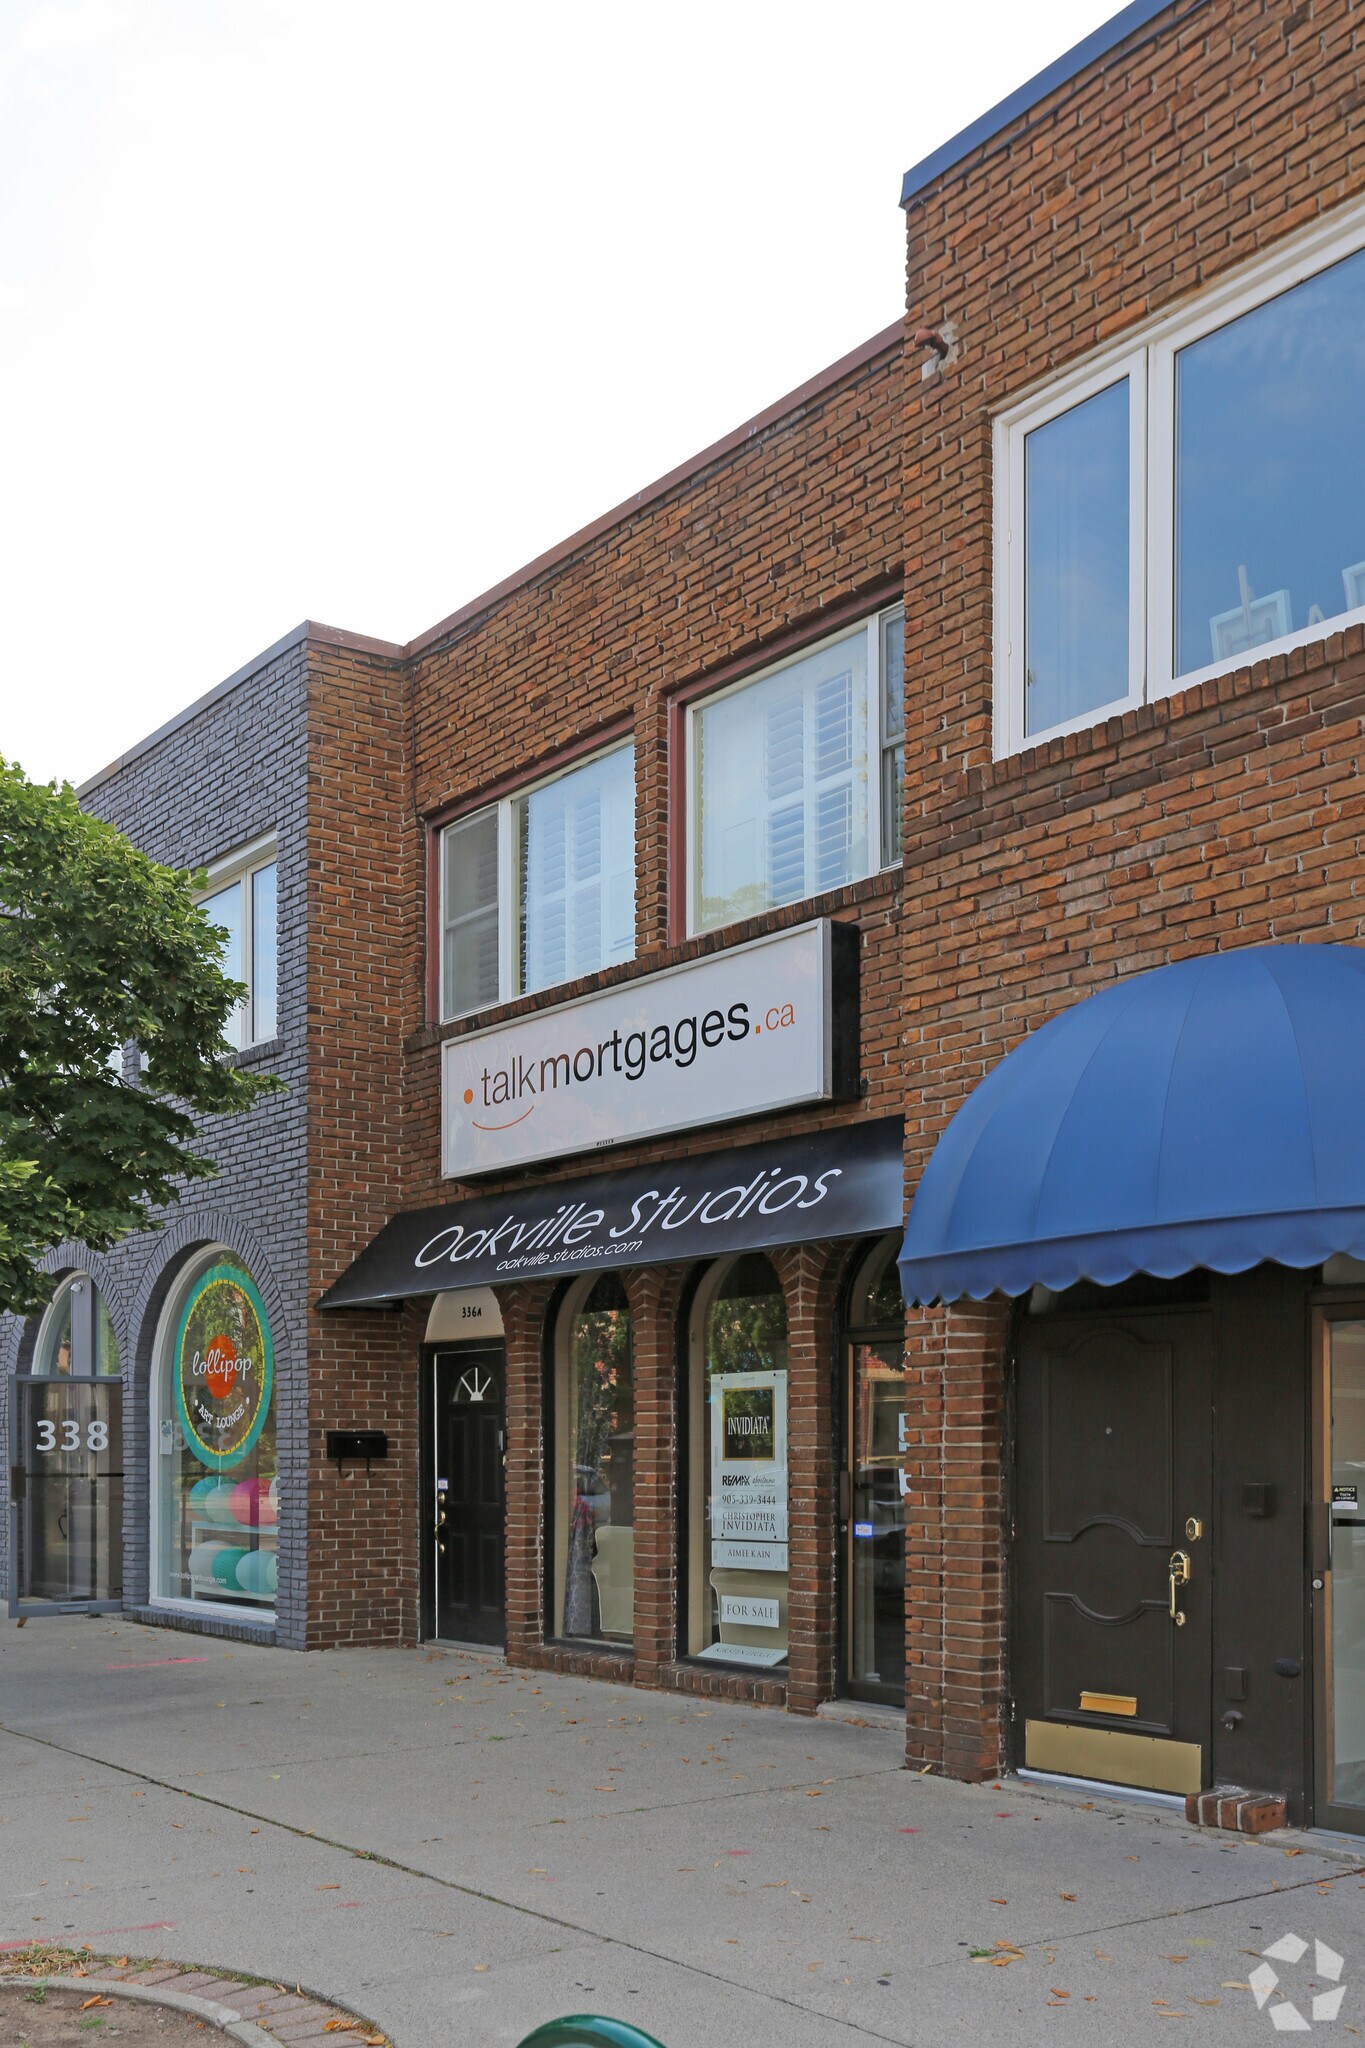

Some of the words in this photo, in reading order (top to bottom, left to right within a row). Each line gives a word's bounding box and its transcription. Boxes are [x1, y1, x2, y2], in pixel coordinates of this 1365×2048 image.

[480, 1002, 795, 1107] talkmortgages.ca
[414, 1202, 605, 1268] Oakville
[609, 1167, 842, 1239] Studios
[496, 1252, 550, 1271] oakville
[549, 1240, 643, 1263] studios.com
[461, 1306, 482, 1318] 336A
[192, 1347, 252, 1383] lollipop
[198, 1403, 214, 1425] ART
[216, 1403, 245, 1429] LOUNGE
[727, 1416, 769, 1435] INVIDIATA
[36, 1419, 109, 1451] 338
[722, 1475, 750, 1487] RE/MAX
[721, 1494, 776, 1505] 905-339-3444
[722, 1511, 776, 1521] CHRISTOPHER
[722, 1520, 776, 1531] INVIDIATA
[727, 1549, 750, 1558] AIMEE
[751, 1550, 771, 1559] KAIN
[726, 1604, 749, 1617] FOR
[752, 1606, 774, 1619] SALE
